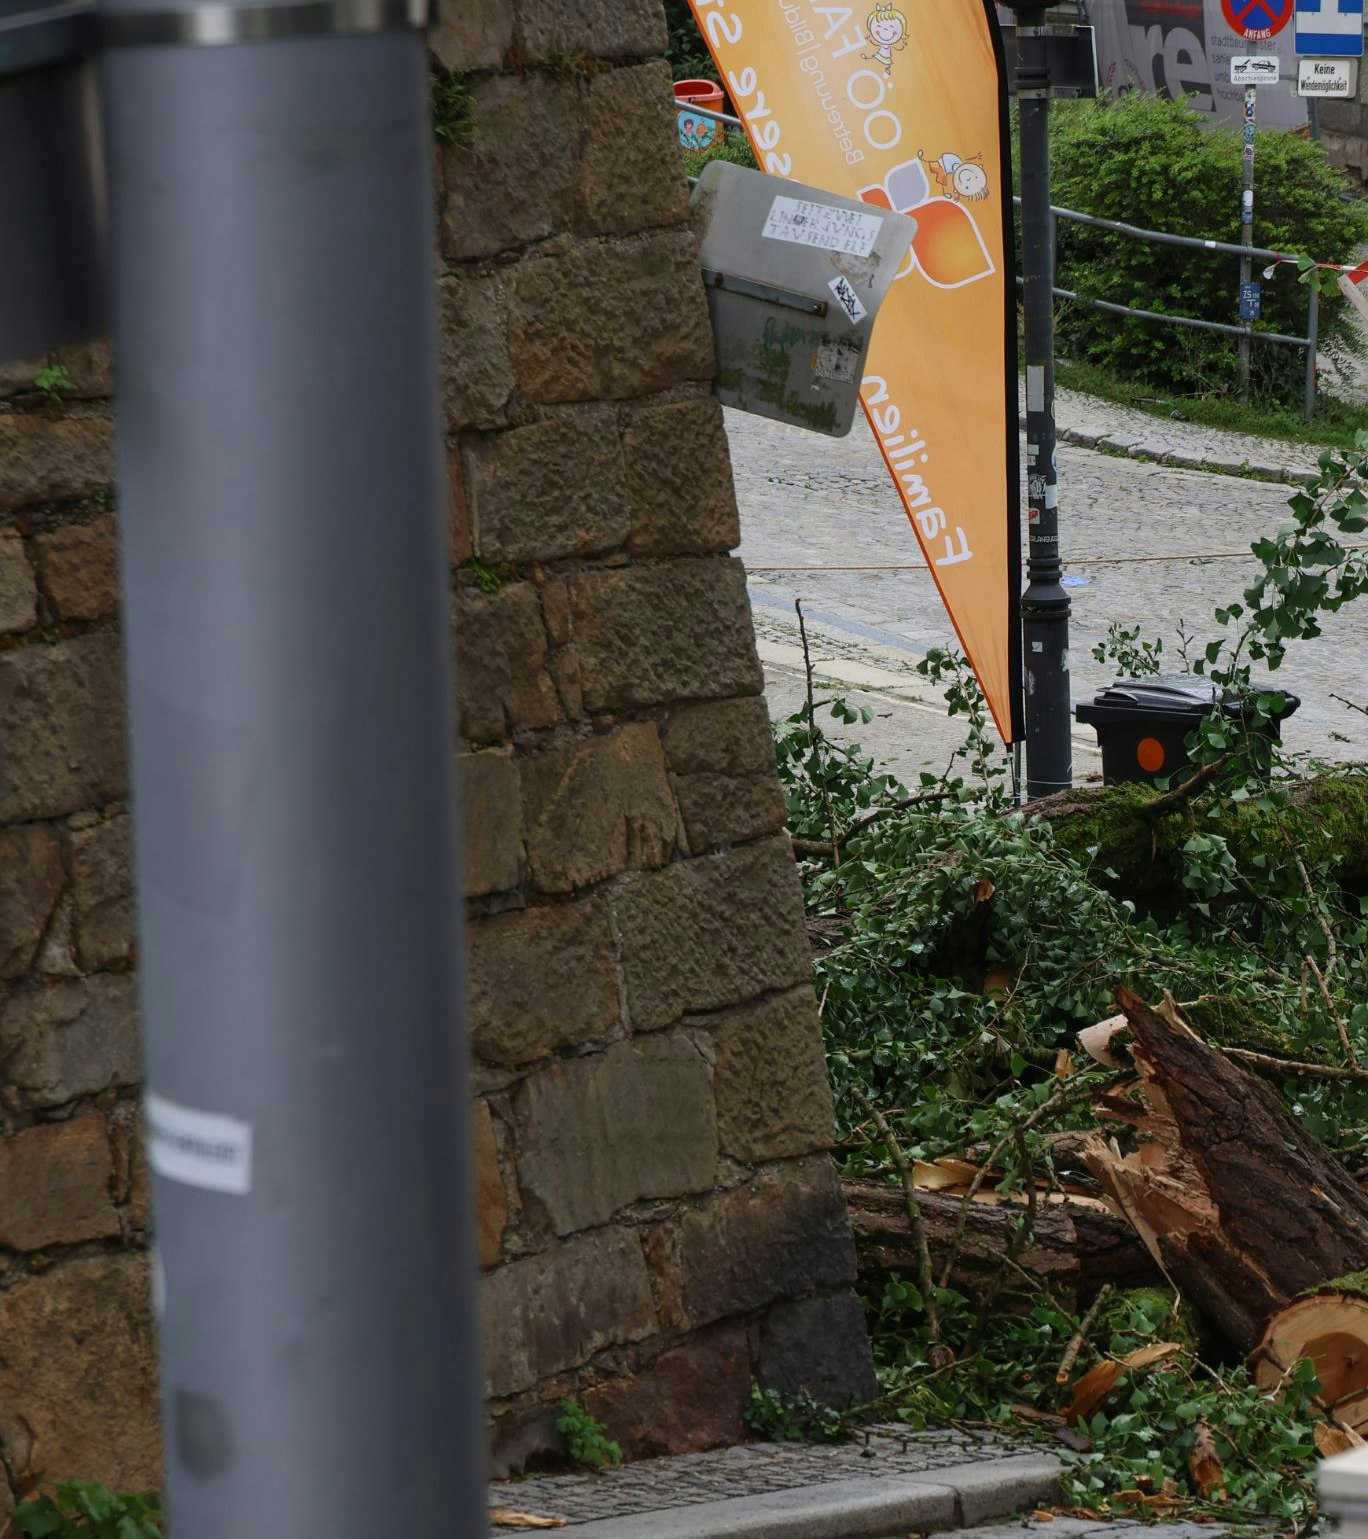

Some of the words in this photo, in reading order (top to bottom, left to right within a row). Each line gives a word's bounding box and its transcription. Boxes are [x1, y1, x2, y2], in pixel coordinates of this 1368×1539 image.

[1243, 28, 1272, 40] ANFANG
[1314, 63, 1336, 75] Keine
[1300, 76, 1348, 93] Wendemöglichkeit
